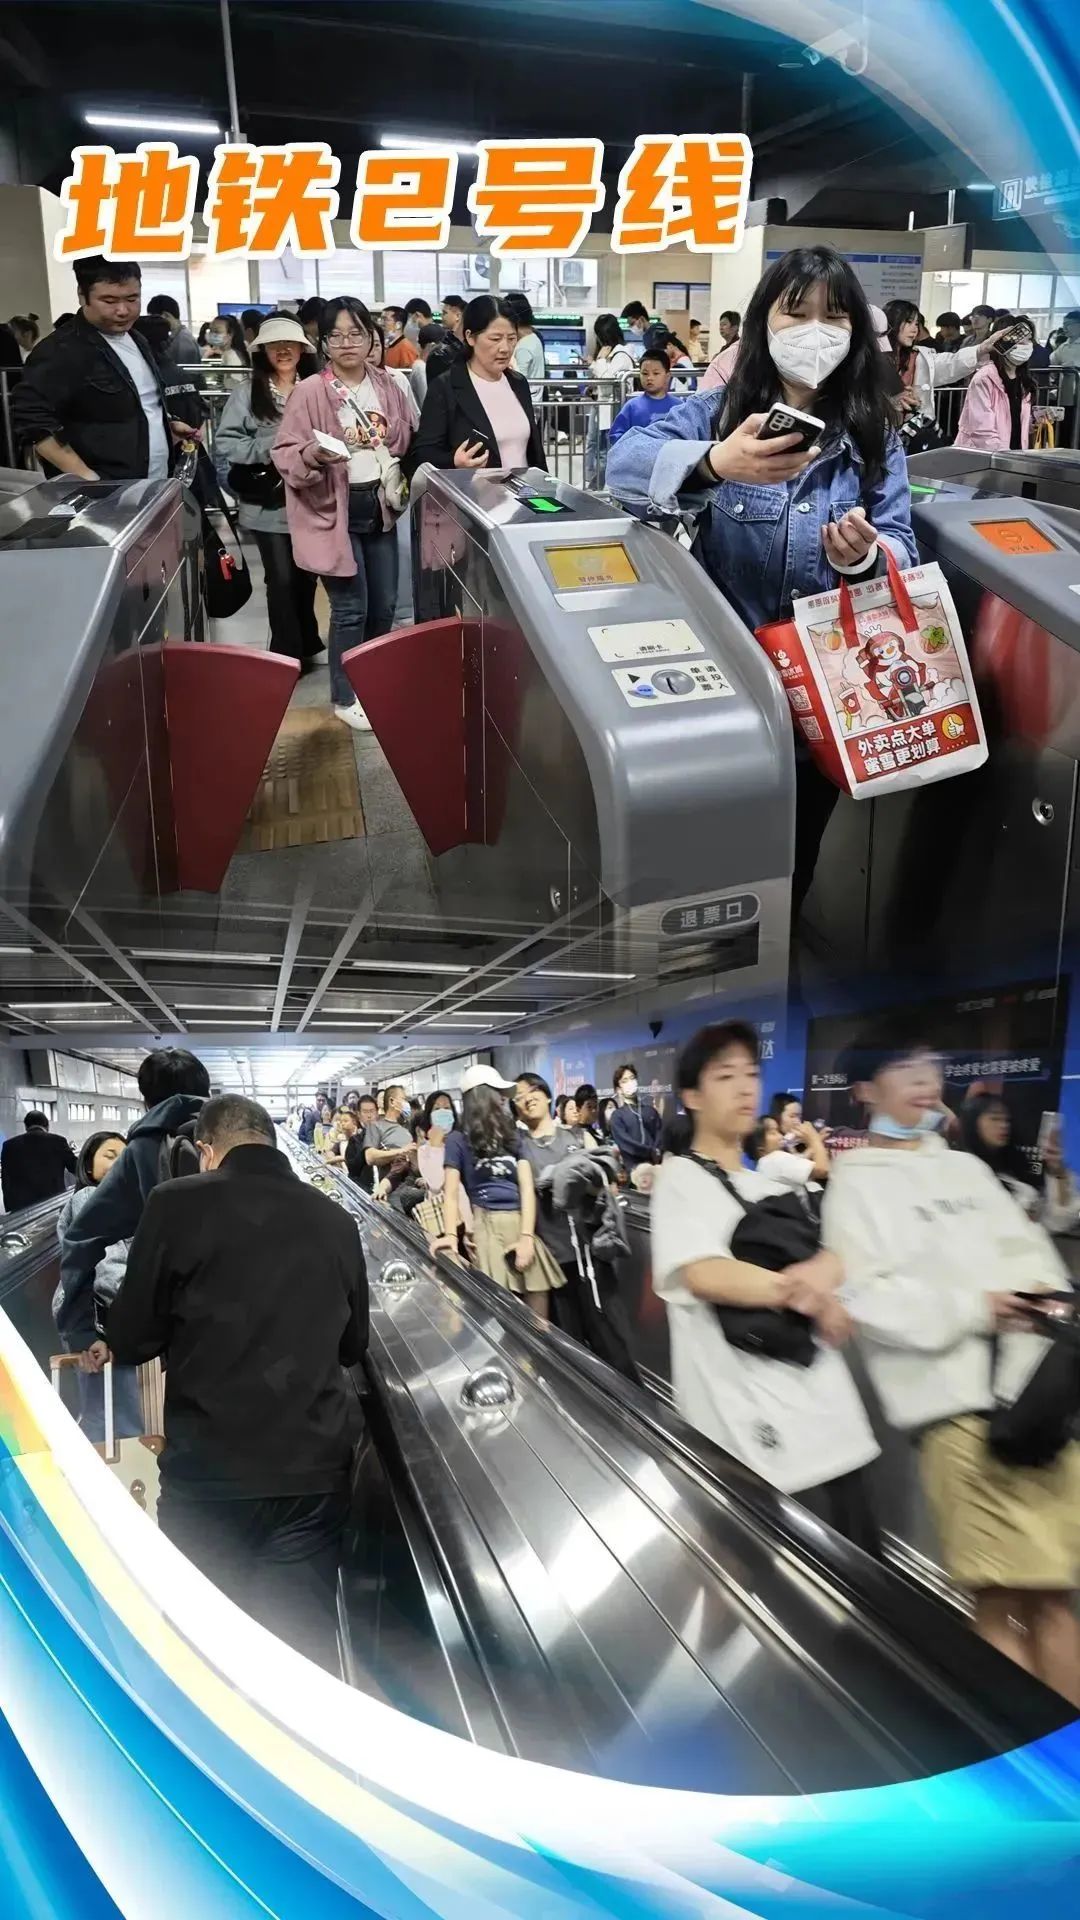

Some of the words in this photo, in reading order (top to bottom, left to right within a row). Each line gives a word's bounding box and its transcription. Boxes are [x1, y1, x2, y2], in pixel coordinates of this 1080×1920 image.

[858, 720, 937, 757] 外卖点大单
[863, 737, 940, 776] 蜜雪更划算
[680, 902, 742, 929] 退票口
